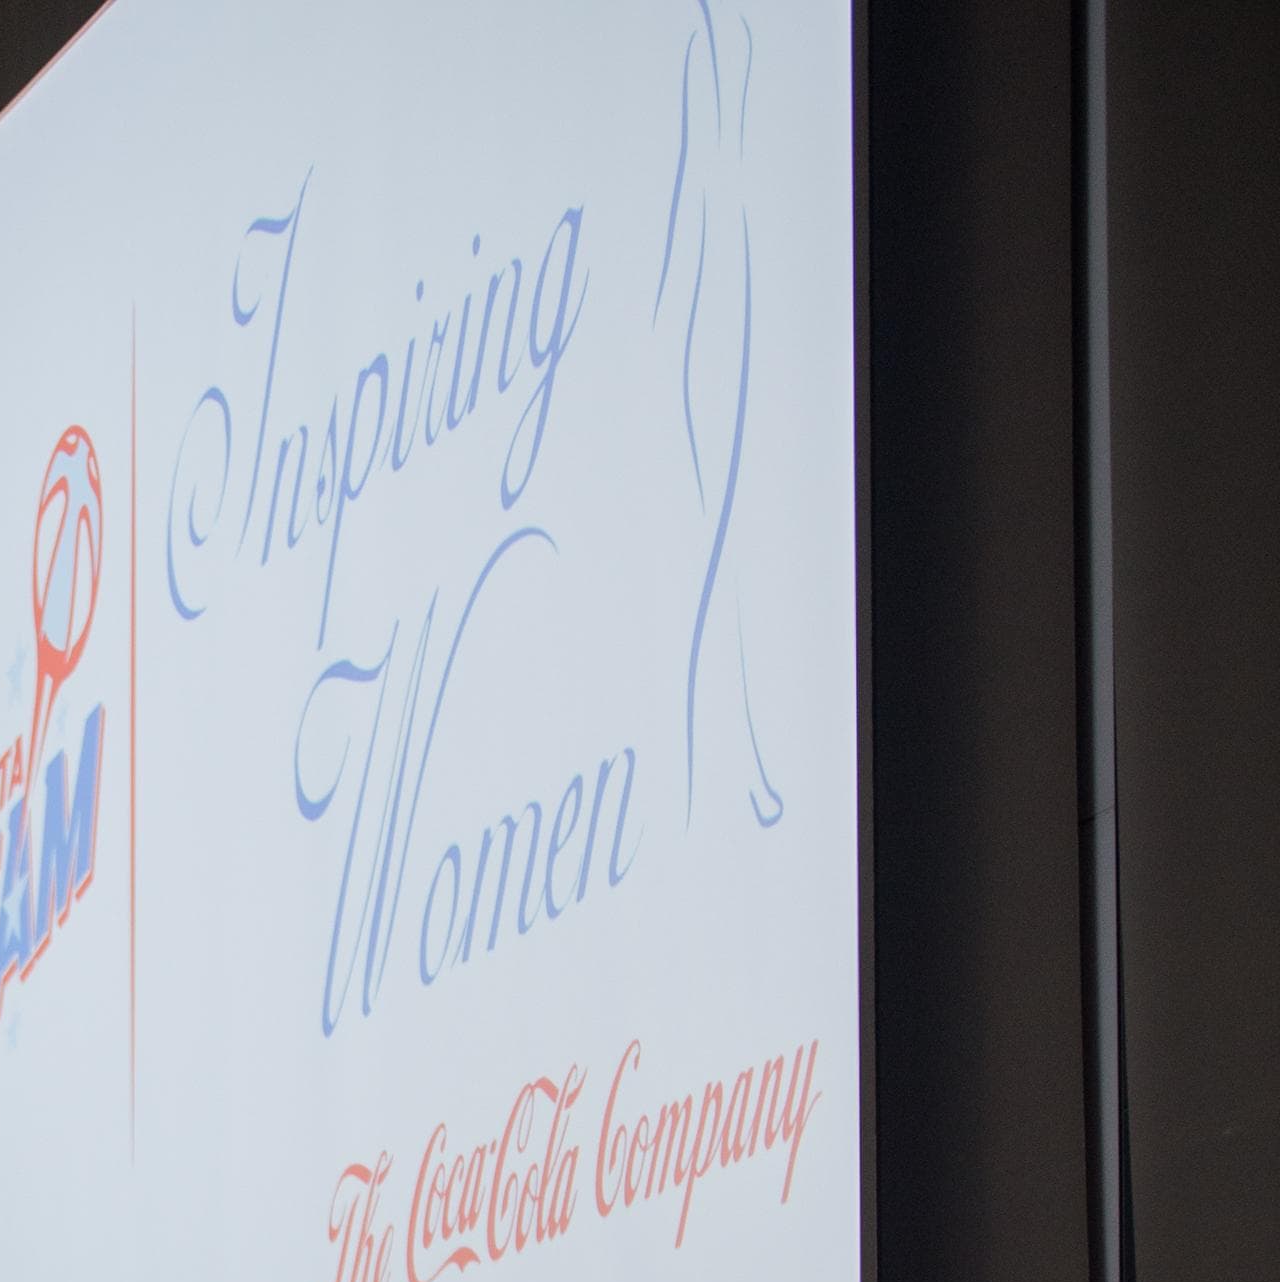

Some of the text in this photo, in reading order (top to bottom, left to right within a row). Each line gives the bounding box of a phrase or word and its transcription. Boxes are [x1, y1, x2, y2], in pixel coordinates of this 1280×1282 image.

[166, 161, 590, 652] Inspiring
[294, 527, 645, 1039] Women
[594, 1038, 823, 1250] Company
